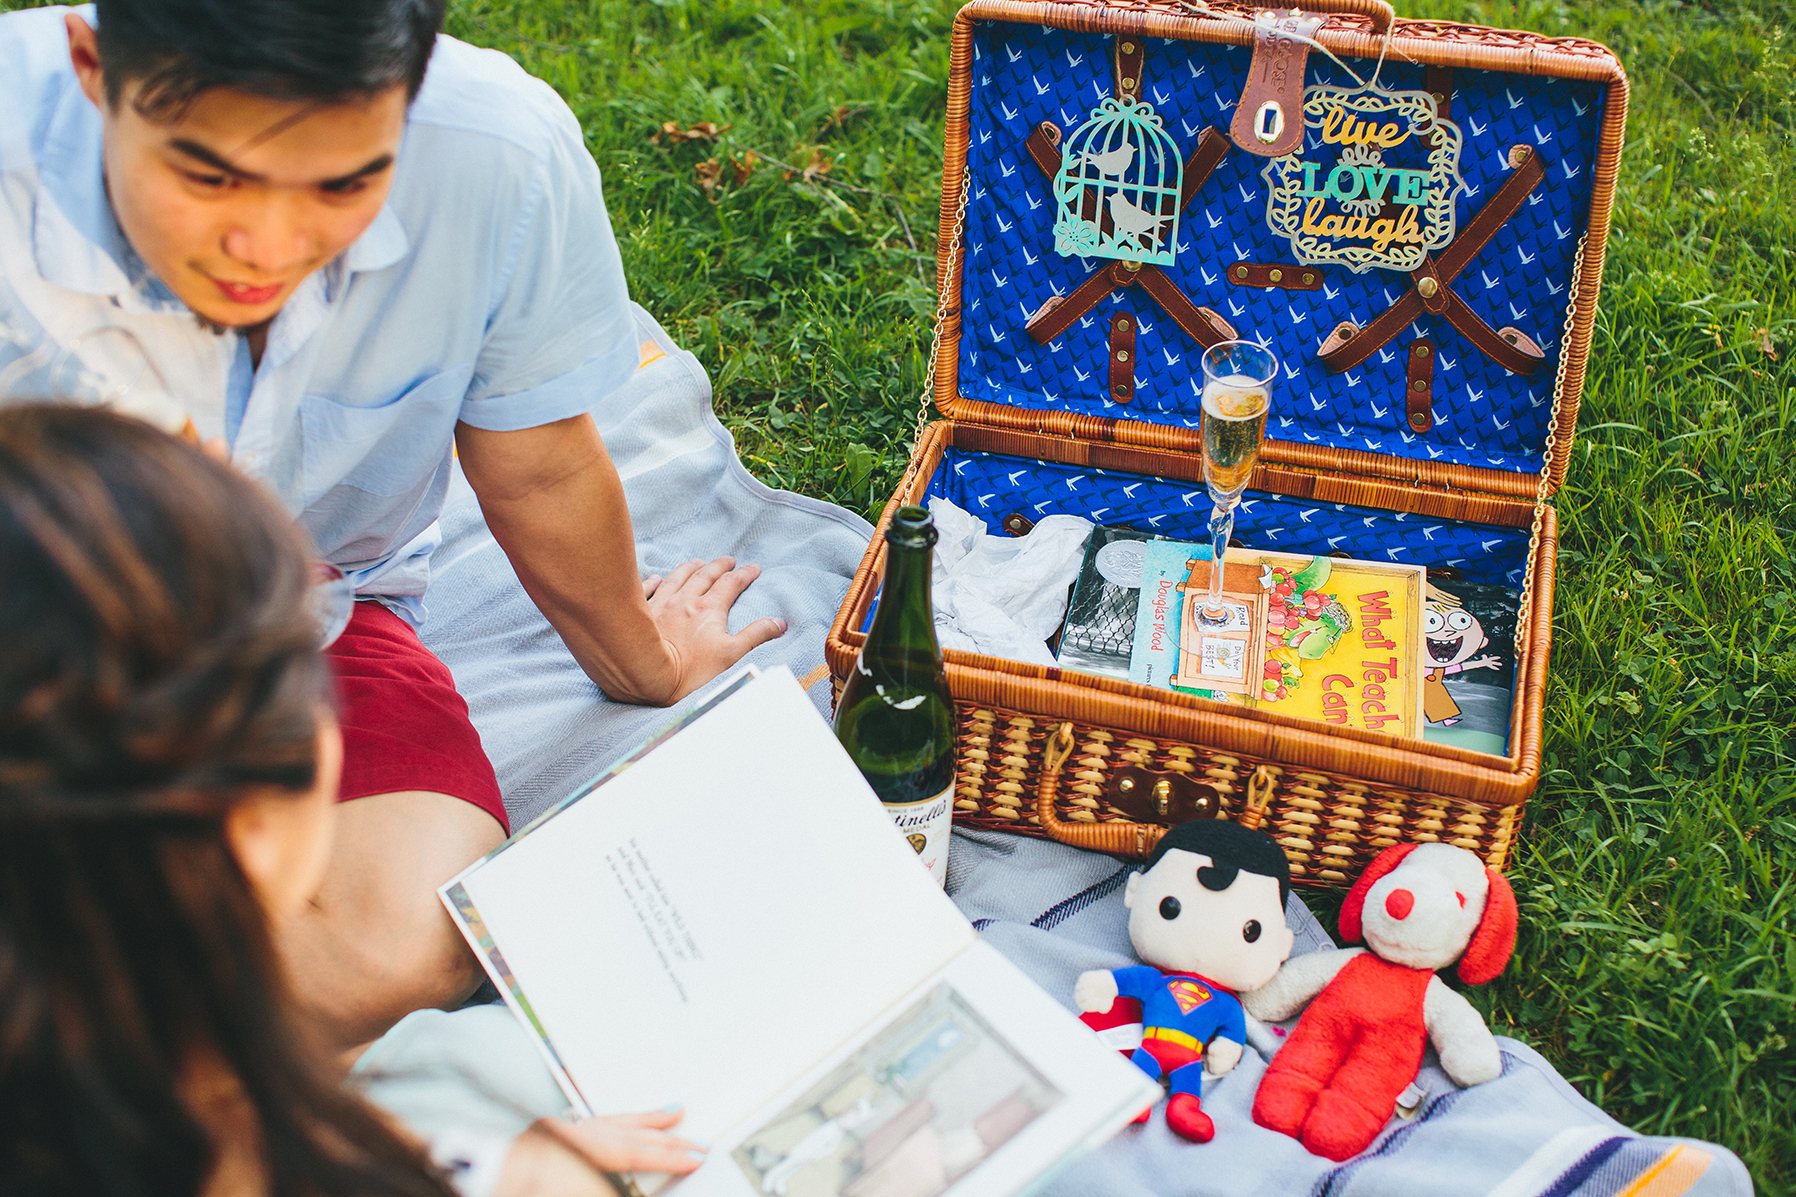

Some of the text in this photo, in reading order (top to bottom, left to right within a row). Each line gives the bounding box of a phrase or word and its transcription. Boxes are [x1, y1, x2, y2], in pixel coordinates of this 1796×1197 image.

[1322, 106, 1411, 148] live
[1296, 162, 1431, 206] LOVE
[1302, 197, 1425, 251] laugh
[1150, 580, 1173, 651] Douglas Wood
[1236, 606, 1248, 626] Read
[1357, 590, 1399, 733] What Teach
[1322, 674, 1355, 725] Can
[903, 824, 931, 834] MEDAL
